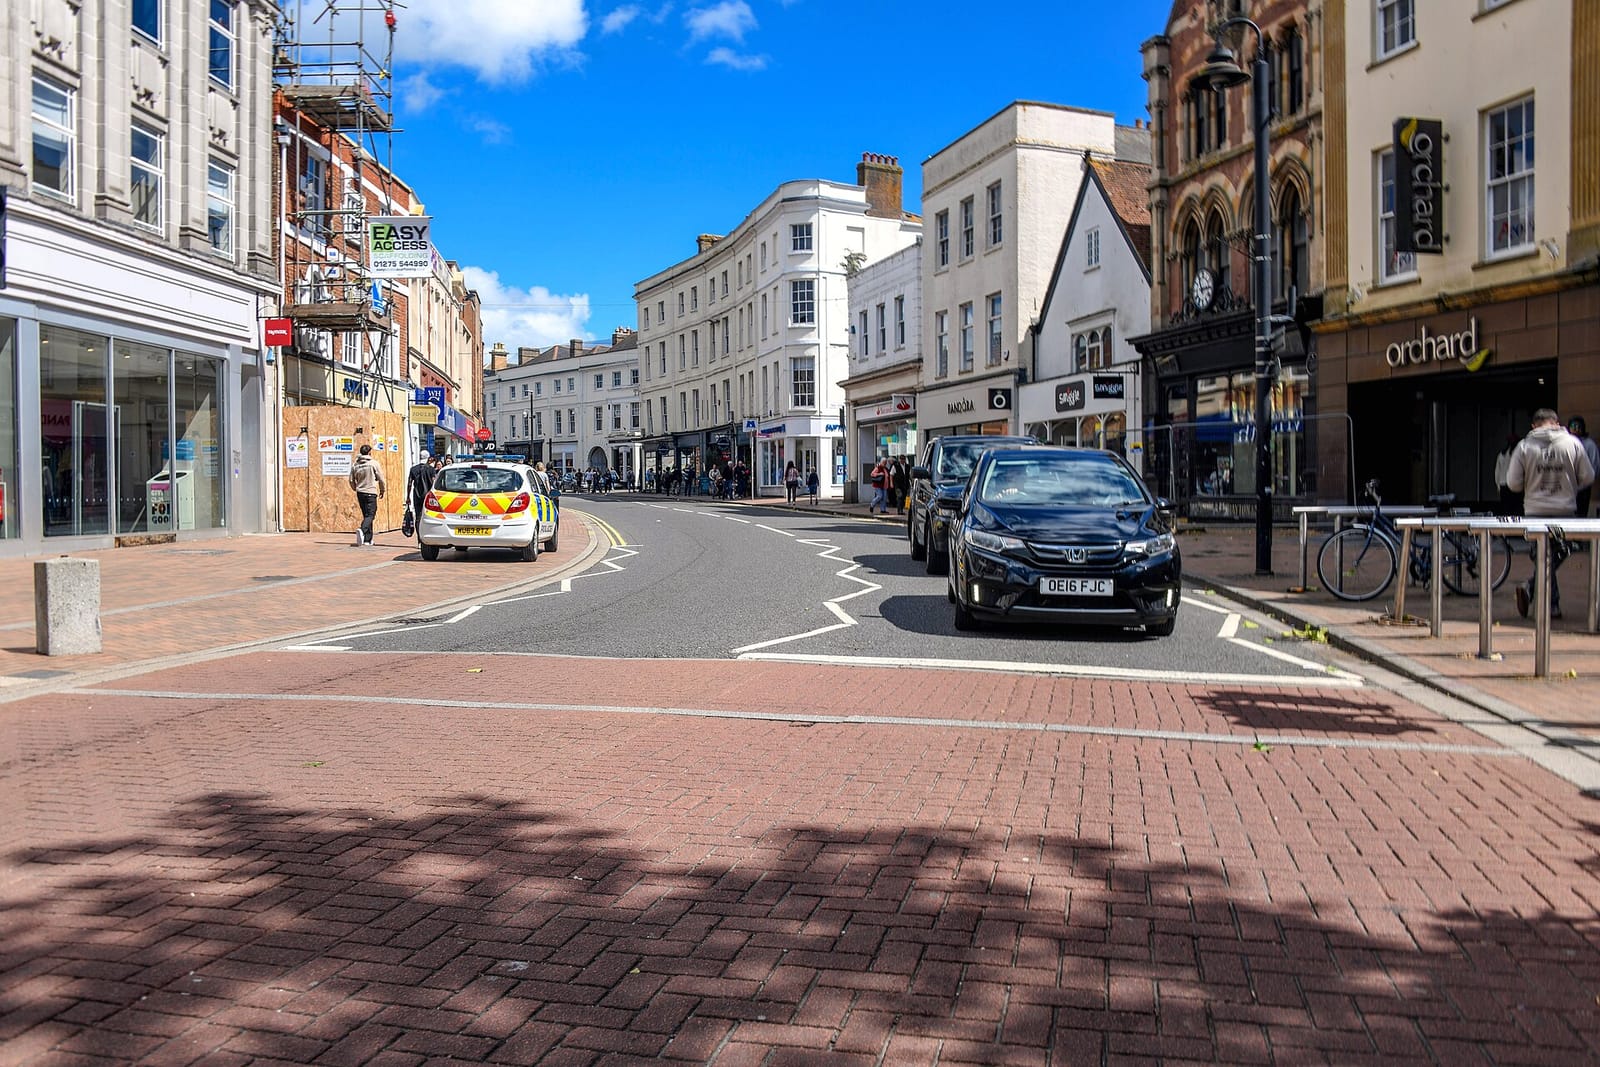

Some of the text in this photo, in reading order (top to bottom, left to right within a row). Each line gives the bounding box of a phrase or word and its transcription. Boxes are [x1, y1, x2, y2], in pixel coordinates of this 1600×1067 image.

[1413, 132, 1441, 249] orchard
[373, 225, 428, 240] EASY
[373, 240, 428, 251] ACCESS
[373, 260, 397, 268] 01275
[1386, 315, 1476, 367] orchard
[947, 396, 975, 415] PANDORA
[1048, 579, 1105, 593] OE16 FJC
